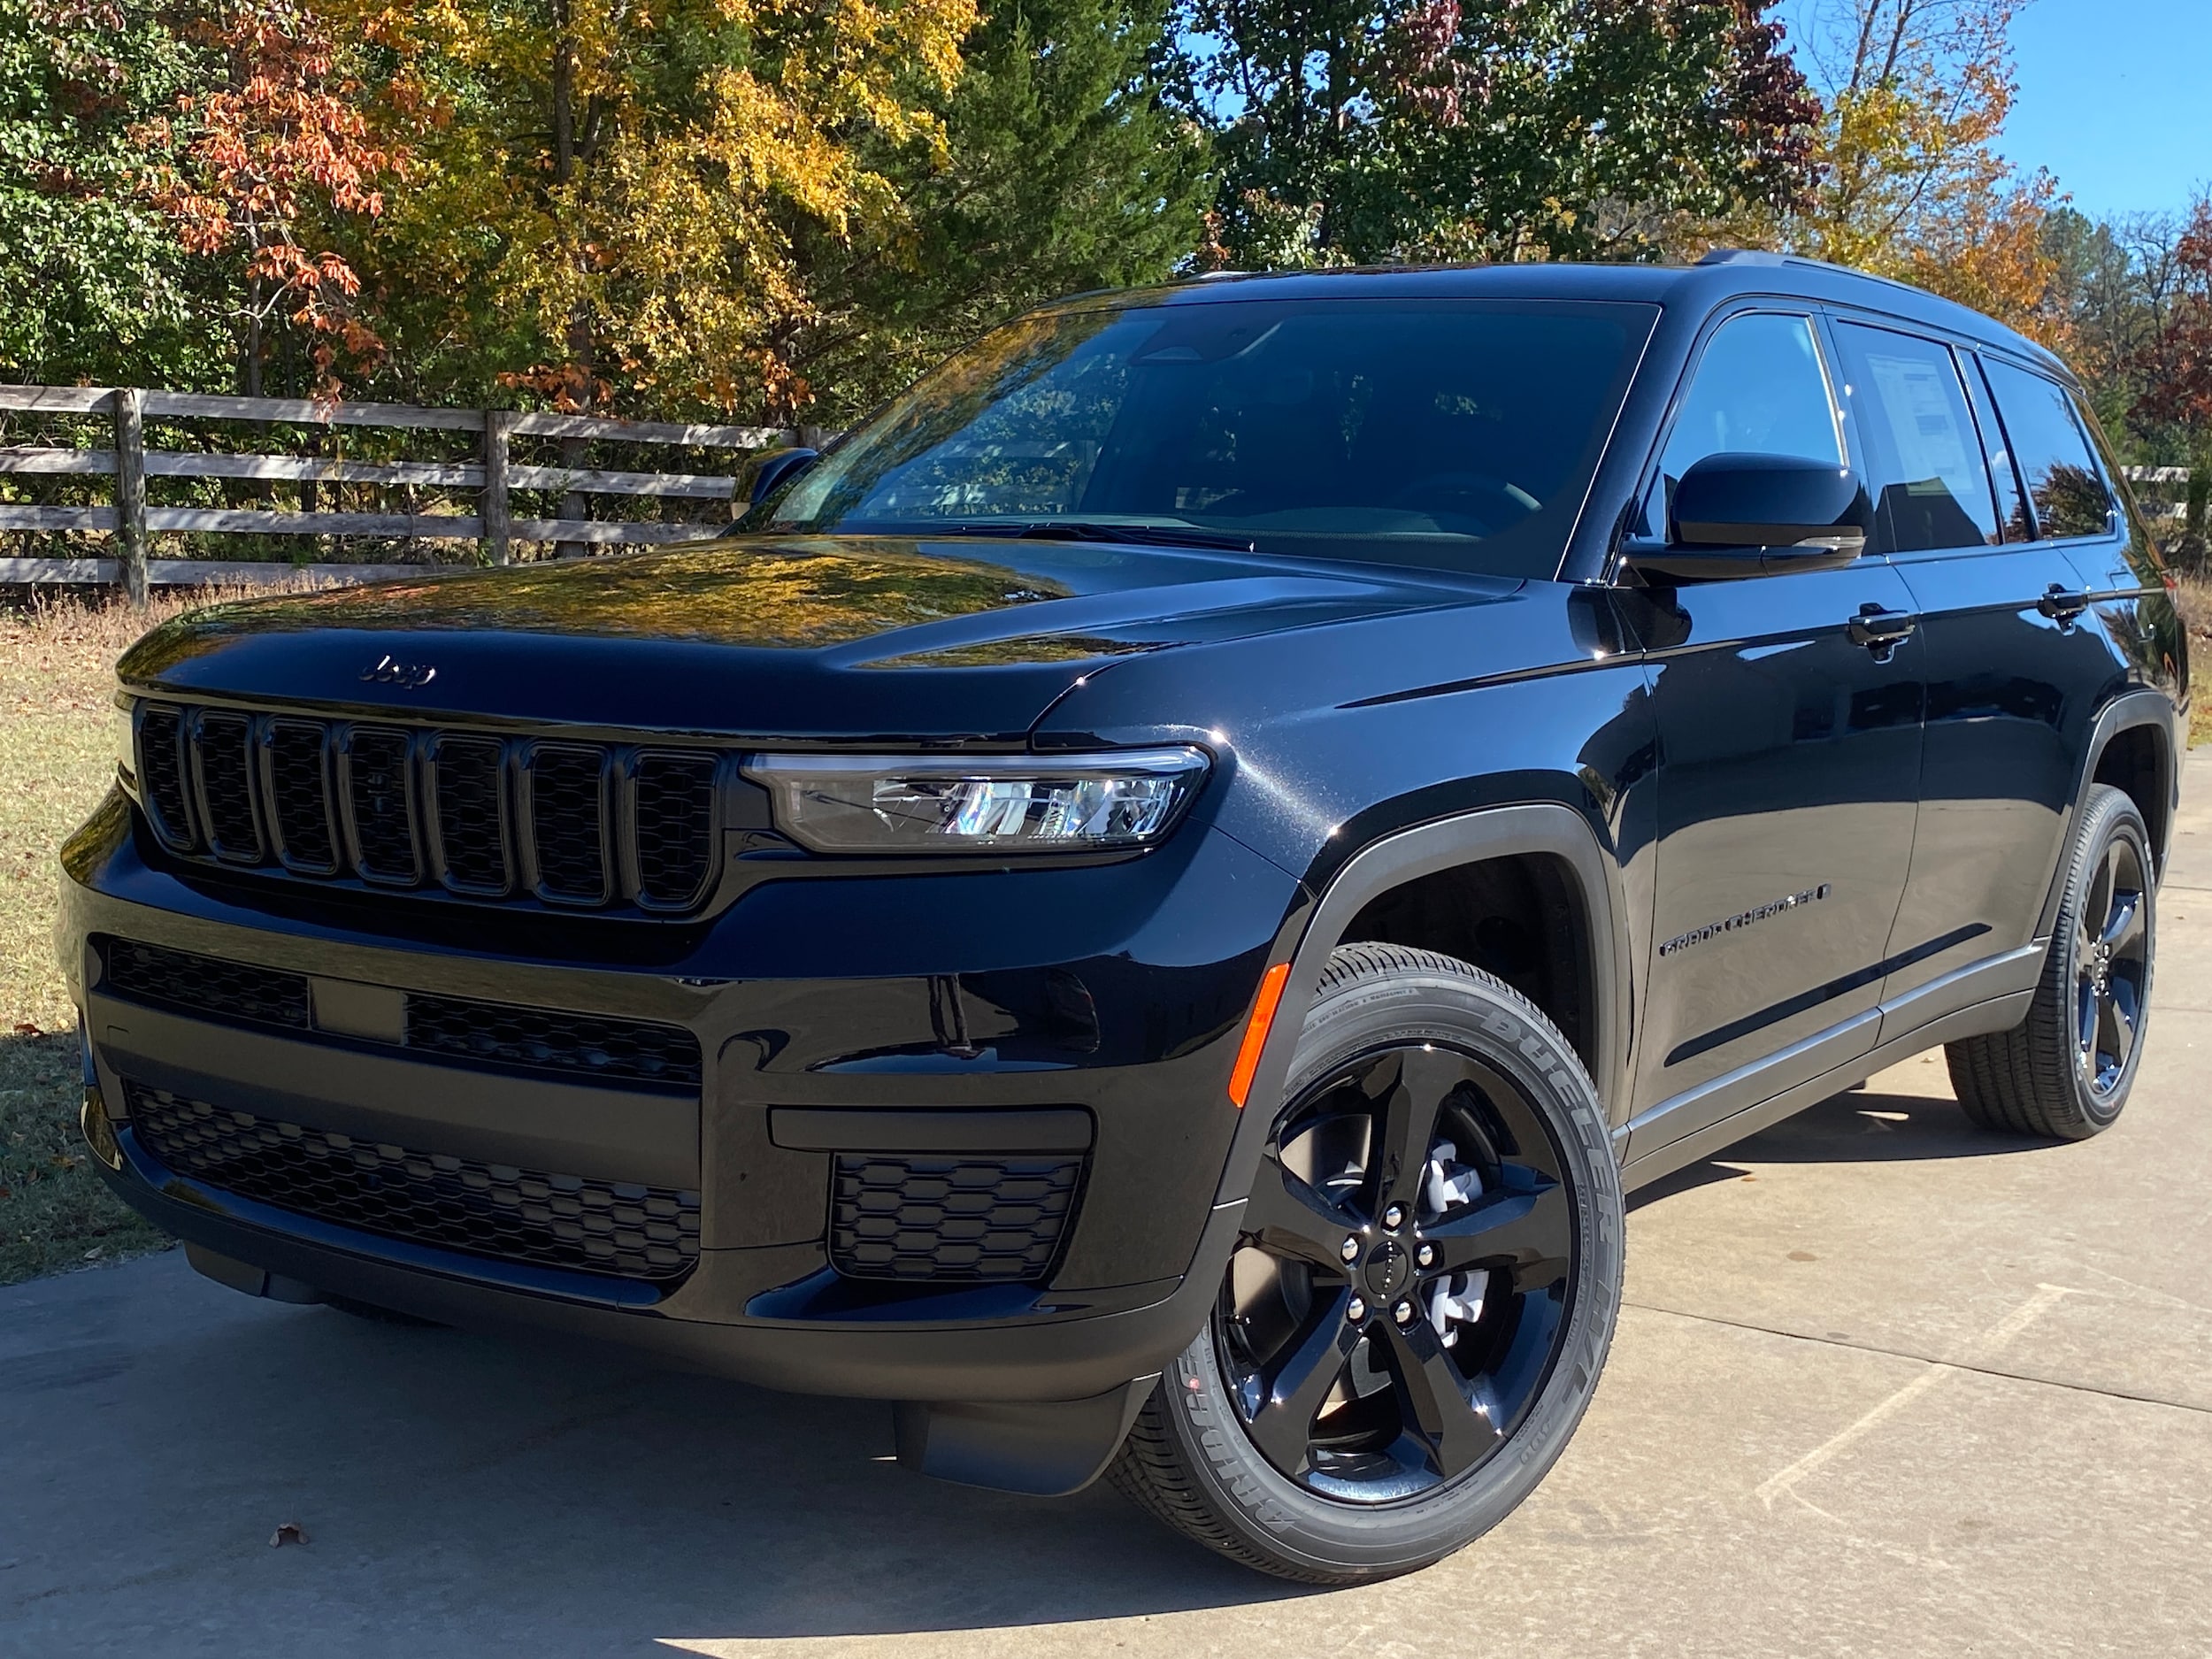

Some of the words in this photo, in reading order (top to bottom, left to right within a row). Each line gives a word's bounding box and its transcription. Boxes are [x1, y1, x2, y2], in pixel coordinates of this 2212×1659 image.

[357, 655, 436, 689] Jeep
[1479, 1010, 1613, 1243] DUELER
[1177, 1346, 1303, 1535] BRIDGE
